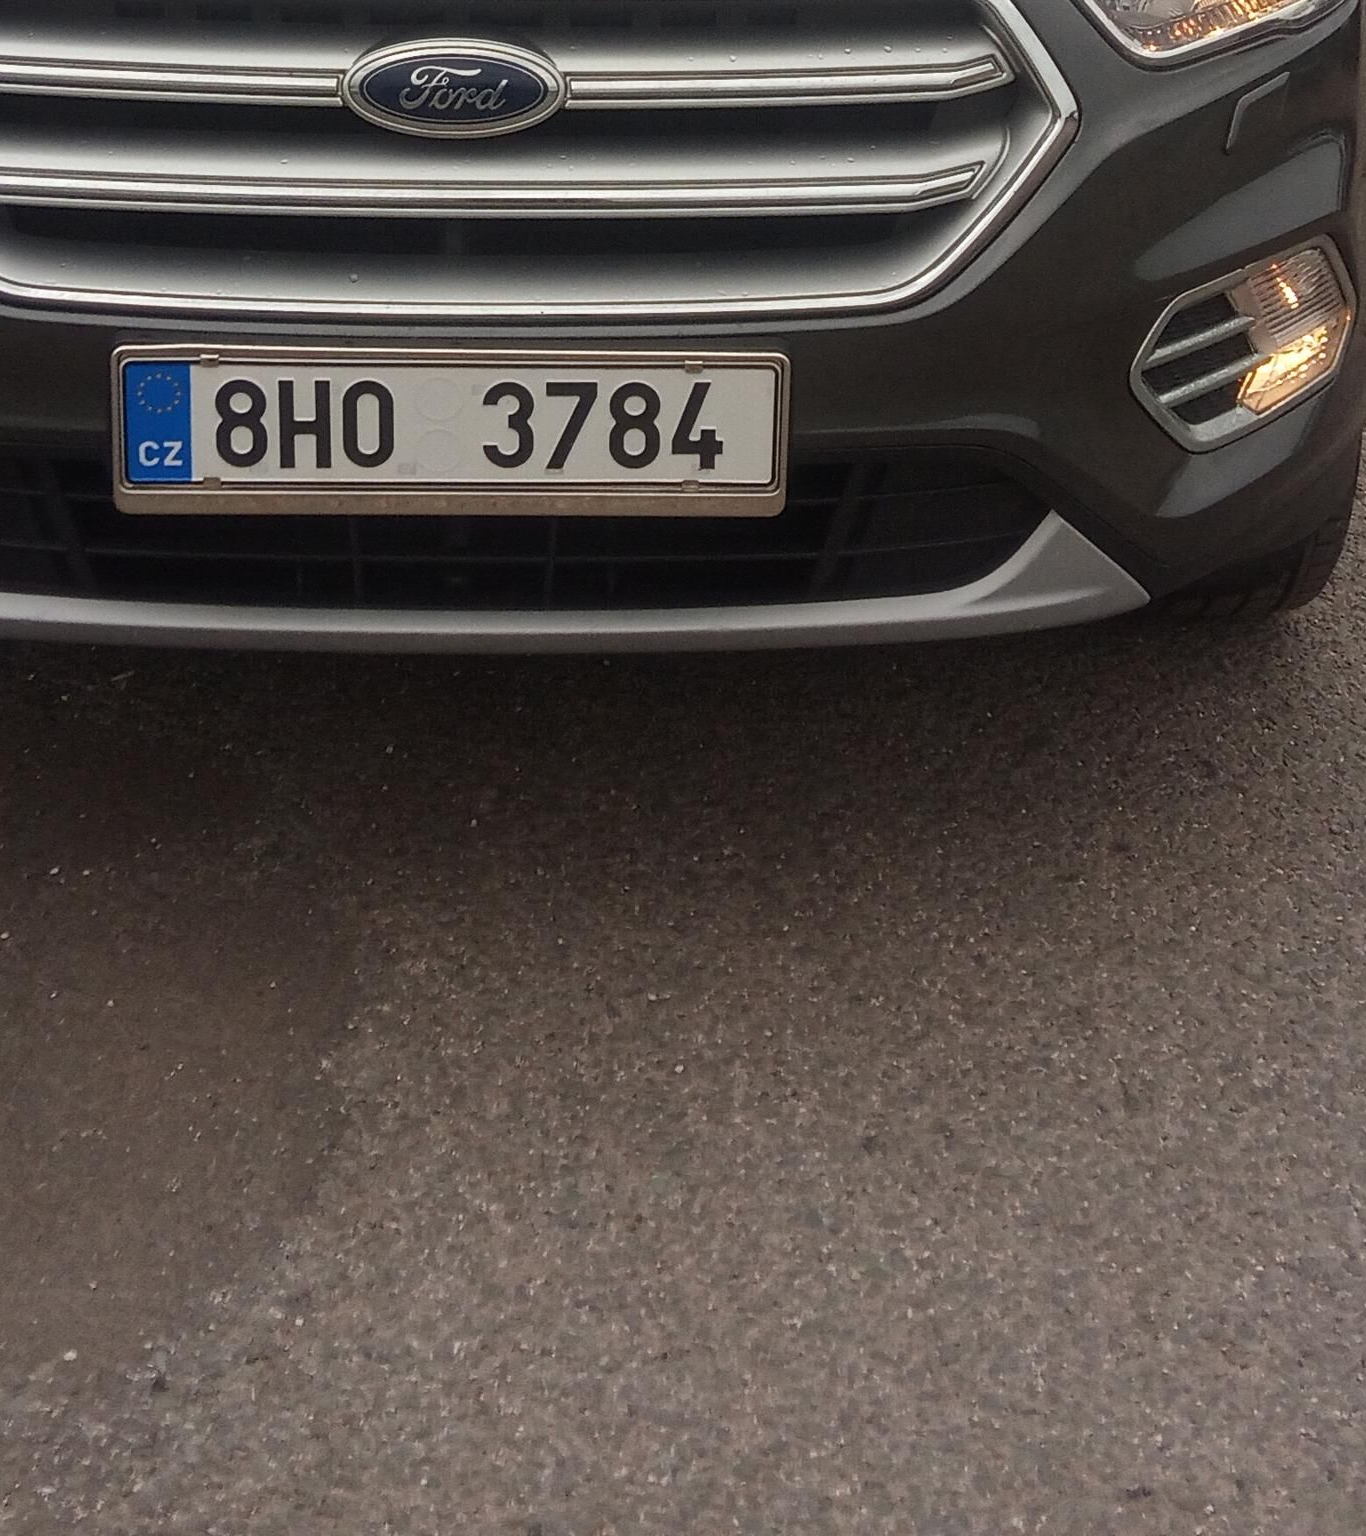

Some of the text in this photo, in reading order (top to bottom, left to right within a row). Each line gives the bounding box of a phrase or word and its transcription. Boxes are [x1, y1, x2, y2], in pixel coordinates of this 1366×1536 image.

[399, 65, 510, 111] Ford
[137, 378, 725, 471] CZ 8H0 3784
